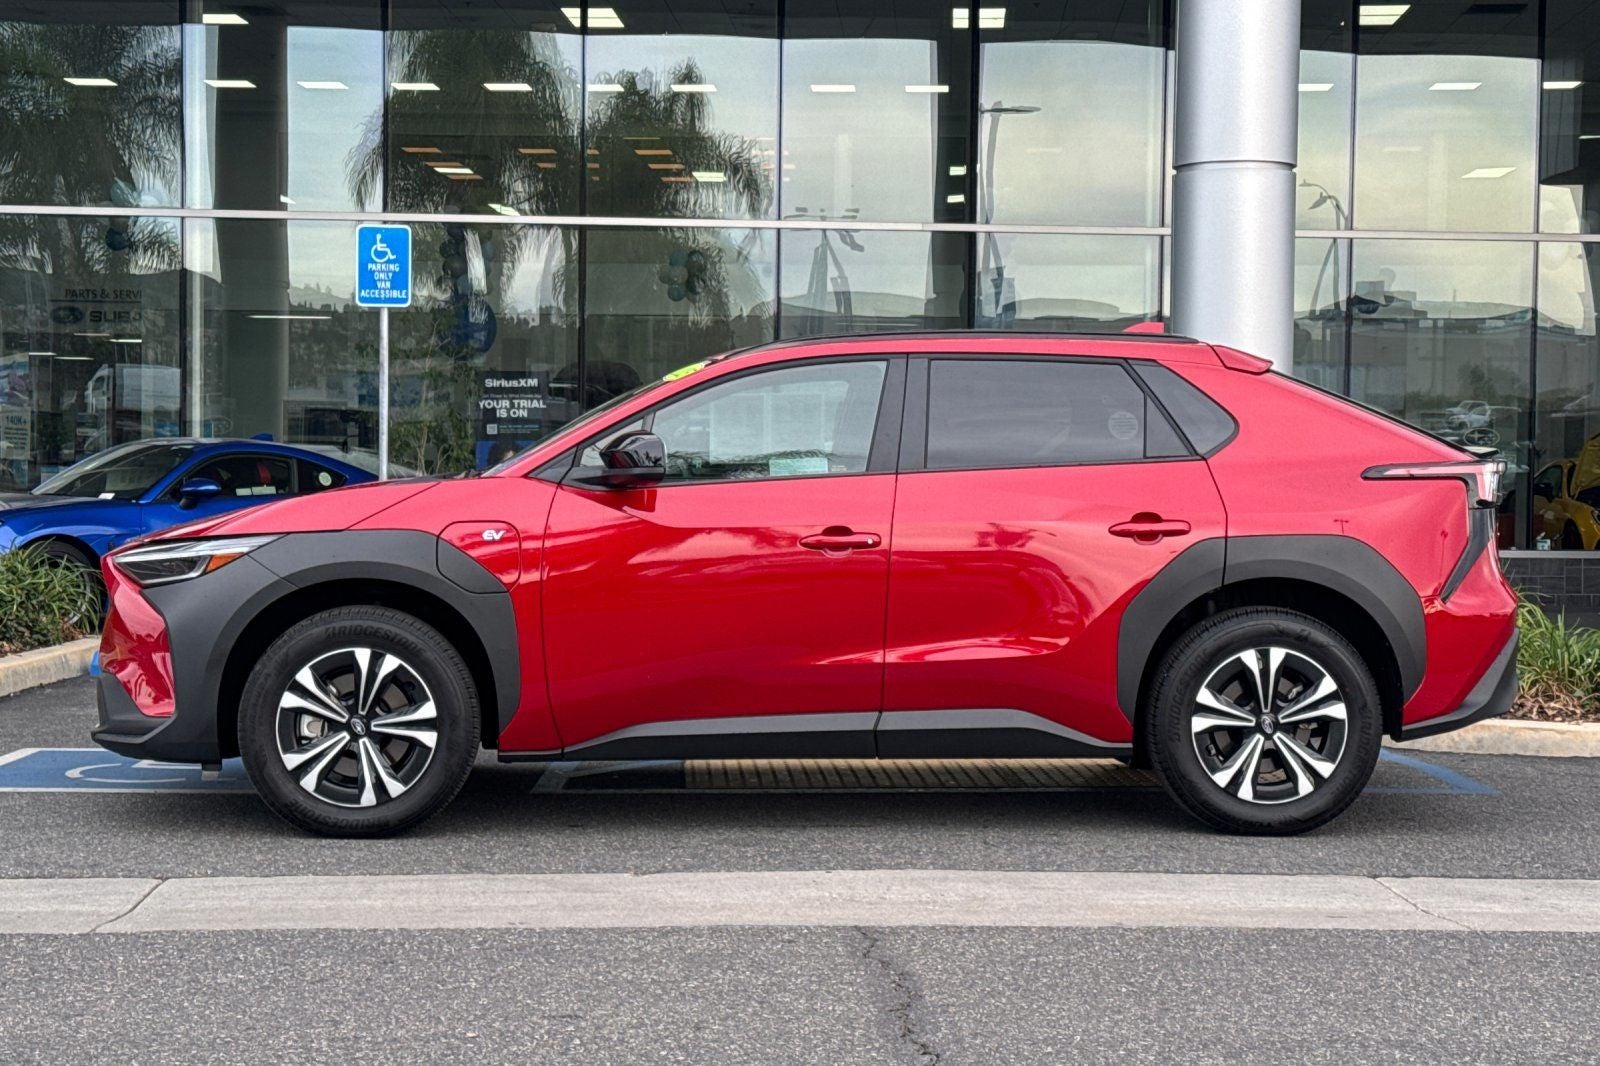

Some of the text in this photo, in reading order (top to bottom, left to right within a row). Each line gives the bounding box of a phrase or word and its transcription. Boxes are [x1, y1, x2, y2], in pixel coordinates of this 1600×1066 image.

[368, 263, 399, 272] PARKING
[374, 272, 393, 280] ONLY
[377, 281, 390, 289] VAN
[65, 289, 97, 298] PARTS
[100, 289, 109, 299] &
[361, 289, 407, 298] ACCESSIBLE
[485, 378, 538, 387] SiriusXM
[479, 400, 546, 408] YOUR TRIAL
[496, 409, 527, 417] IS ON
[482, 529, 506, 540] EV
